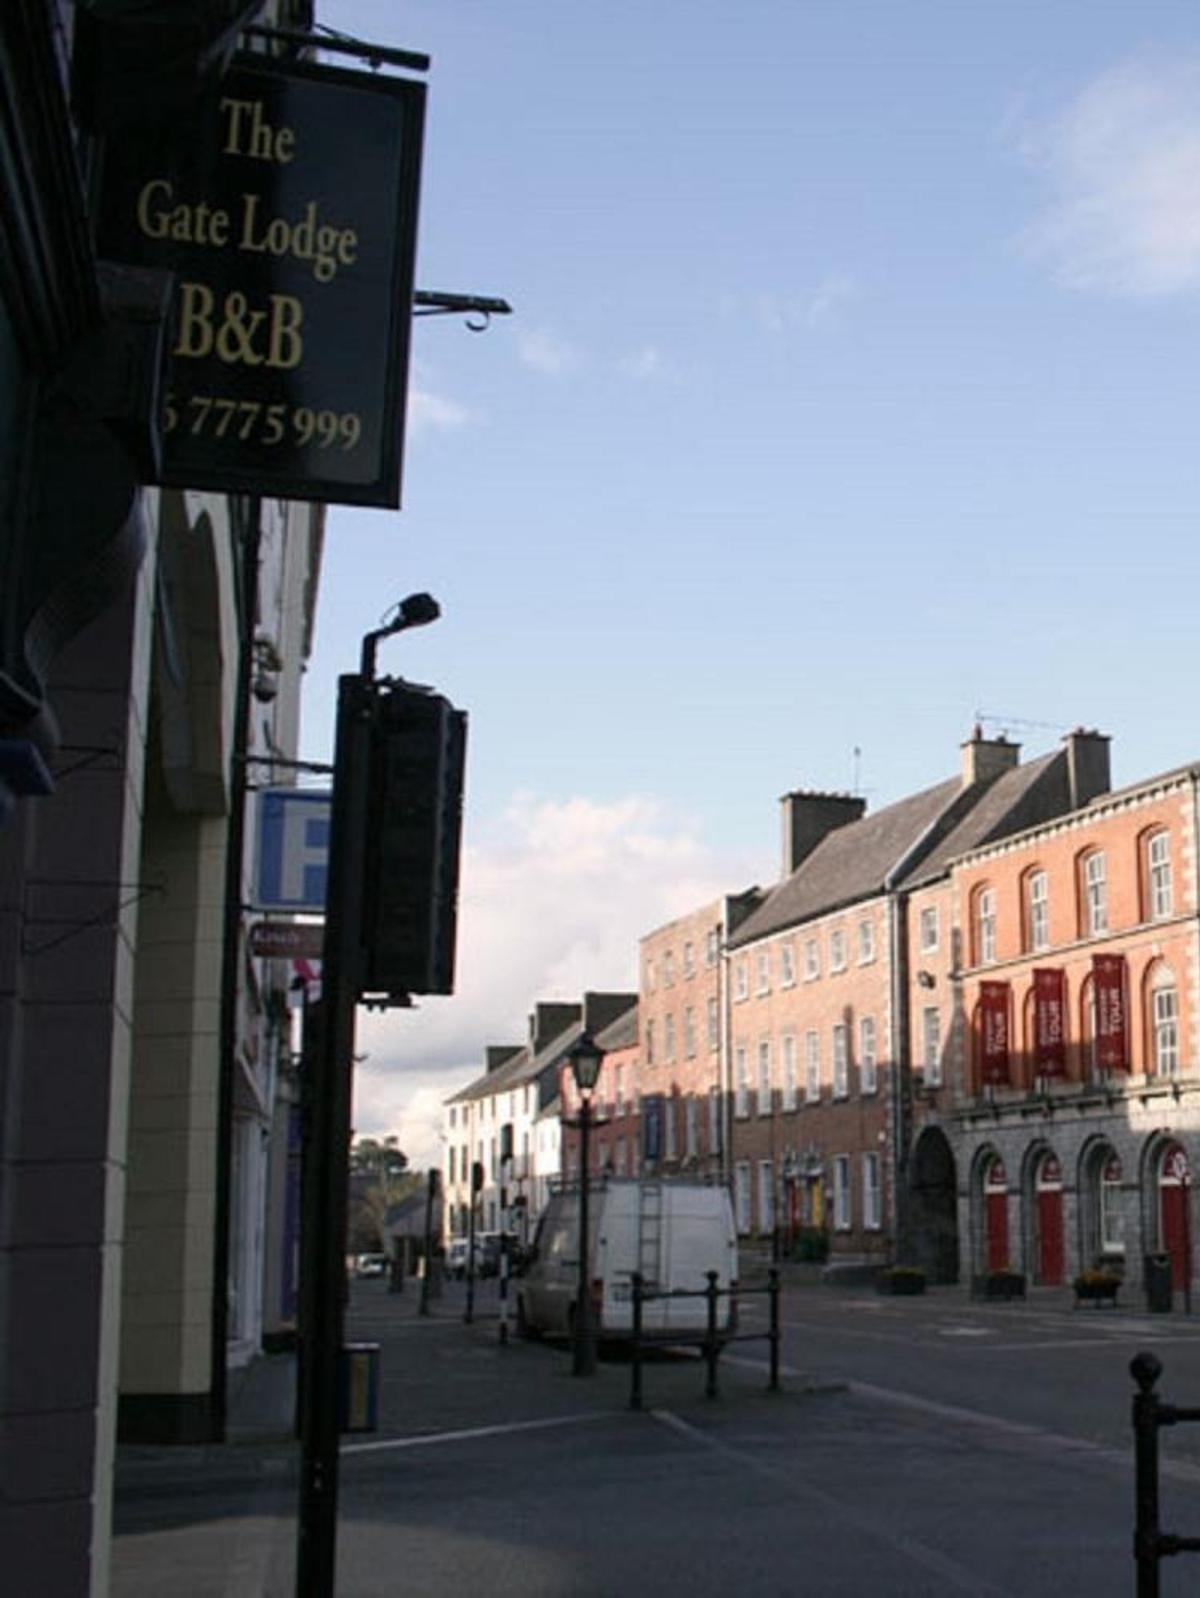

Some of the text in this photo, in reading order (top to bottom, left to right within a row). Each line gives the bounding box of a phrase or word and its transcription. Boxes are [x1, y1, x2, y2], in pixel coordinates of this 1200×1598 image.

[219, 97, 295, 164] The
[137, 180, 358, 283] Gate Lodge
[173, 282, 304, 371] B&B
